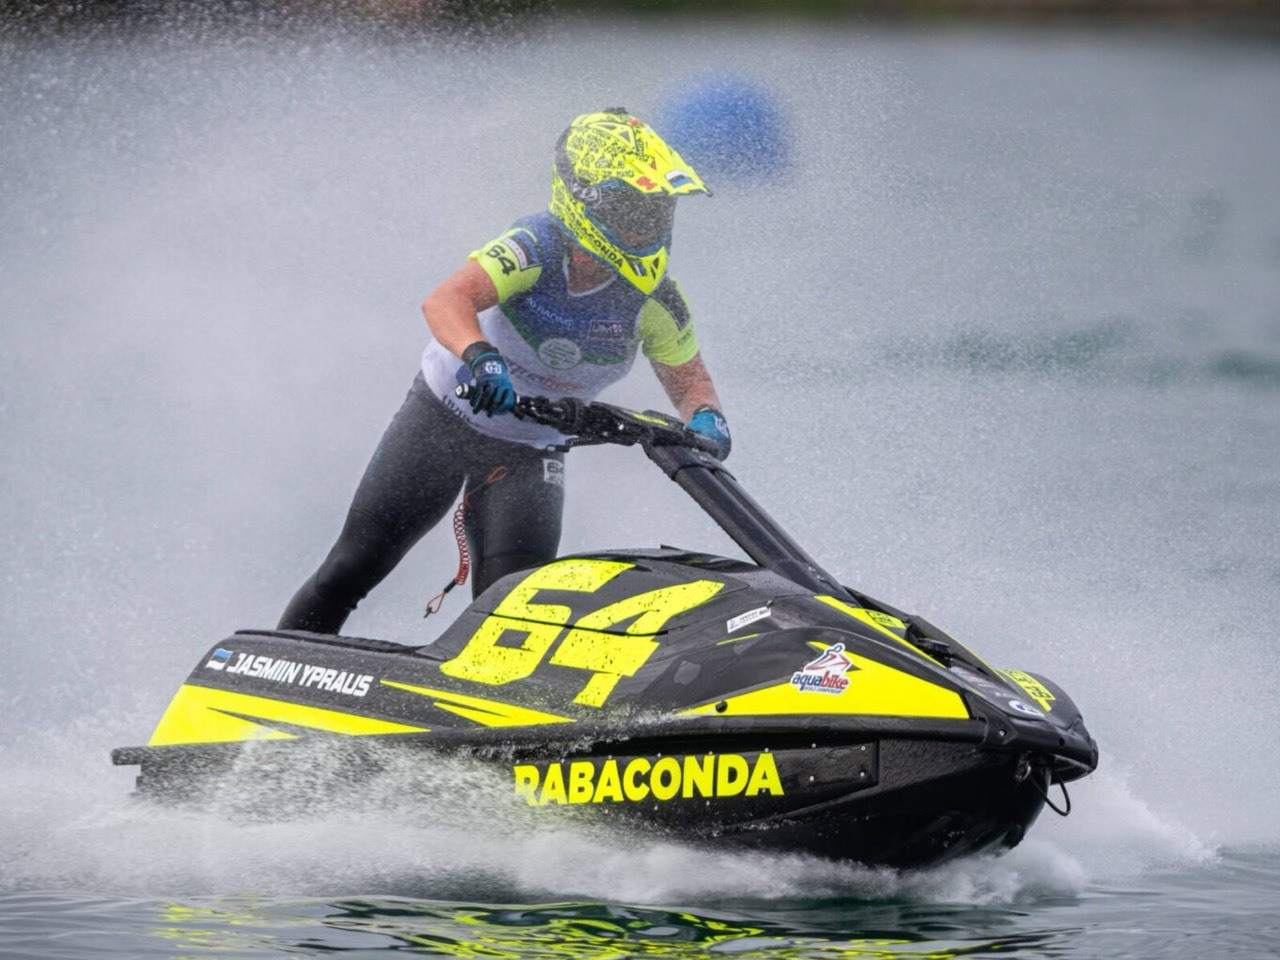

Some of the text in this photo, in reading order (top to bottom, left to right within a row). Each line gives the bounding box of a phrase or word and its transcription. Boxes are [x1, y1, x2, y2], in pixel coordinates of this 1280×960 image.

[486, 244, 516, 276] 64
[440, 559, 724, 708] 64
[226, 653, 374, 697] JASMIIN YPRAUS
[791, 671, 849, 691] aquabike
[513, 752, 785, 807] RABACONDA
